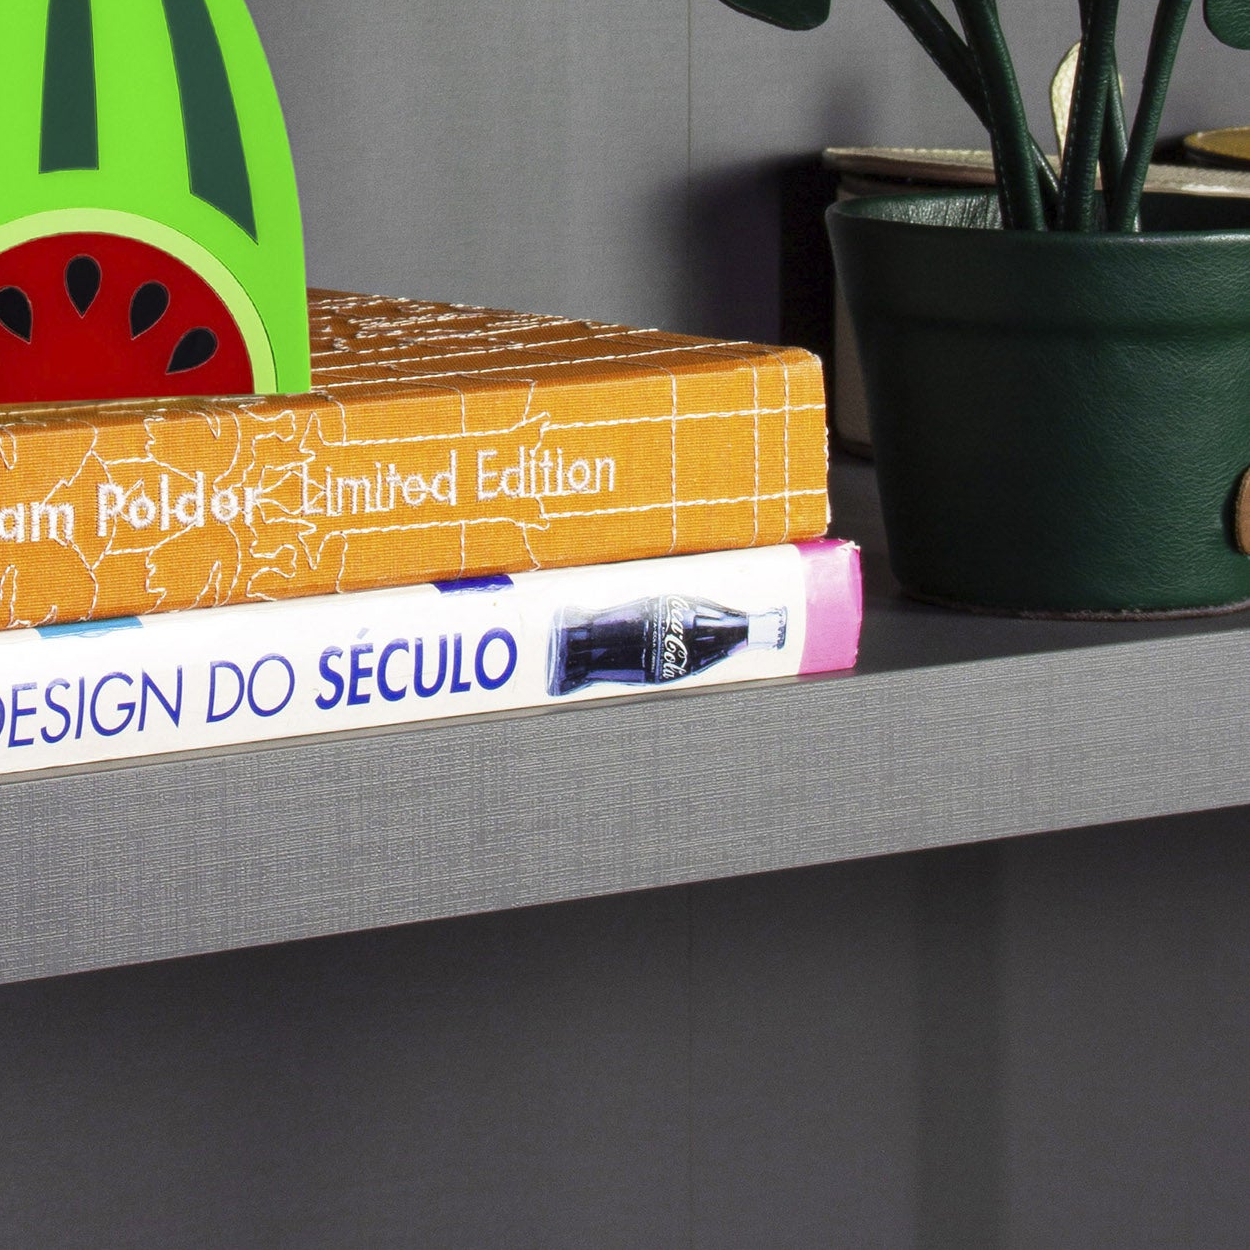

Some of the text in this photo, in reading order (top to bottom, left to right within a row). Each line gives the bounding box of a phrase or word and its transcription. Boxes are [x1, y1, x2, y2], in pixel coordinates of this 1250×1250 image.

[96, 471, 258, 537] Polder
[301, 446, 616, 516] Limited Edition
[207, 653, 295, 724] DO
[315, 626, 518, 710] SÉCULO
